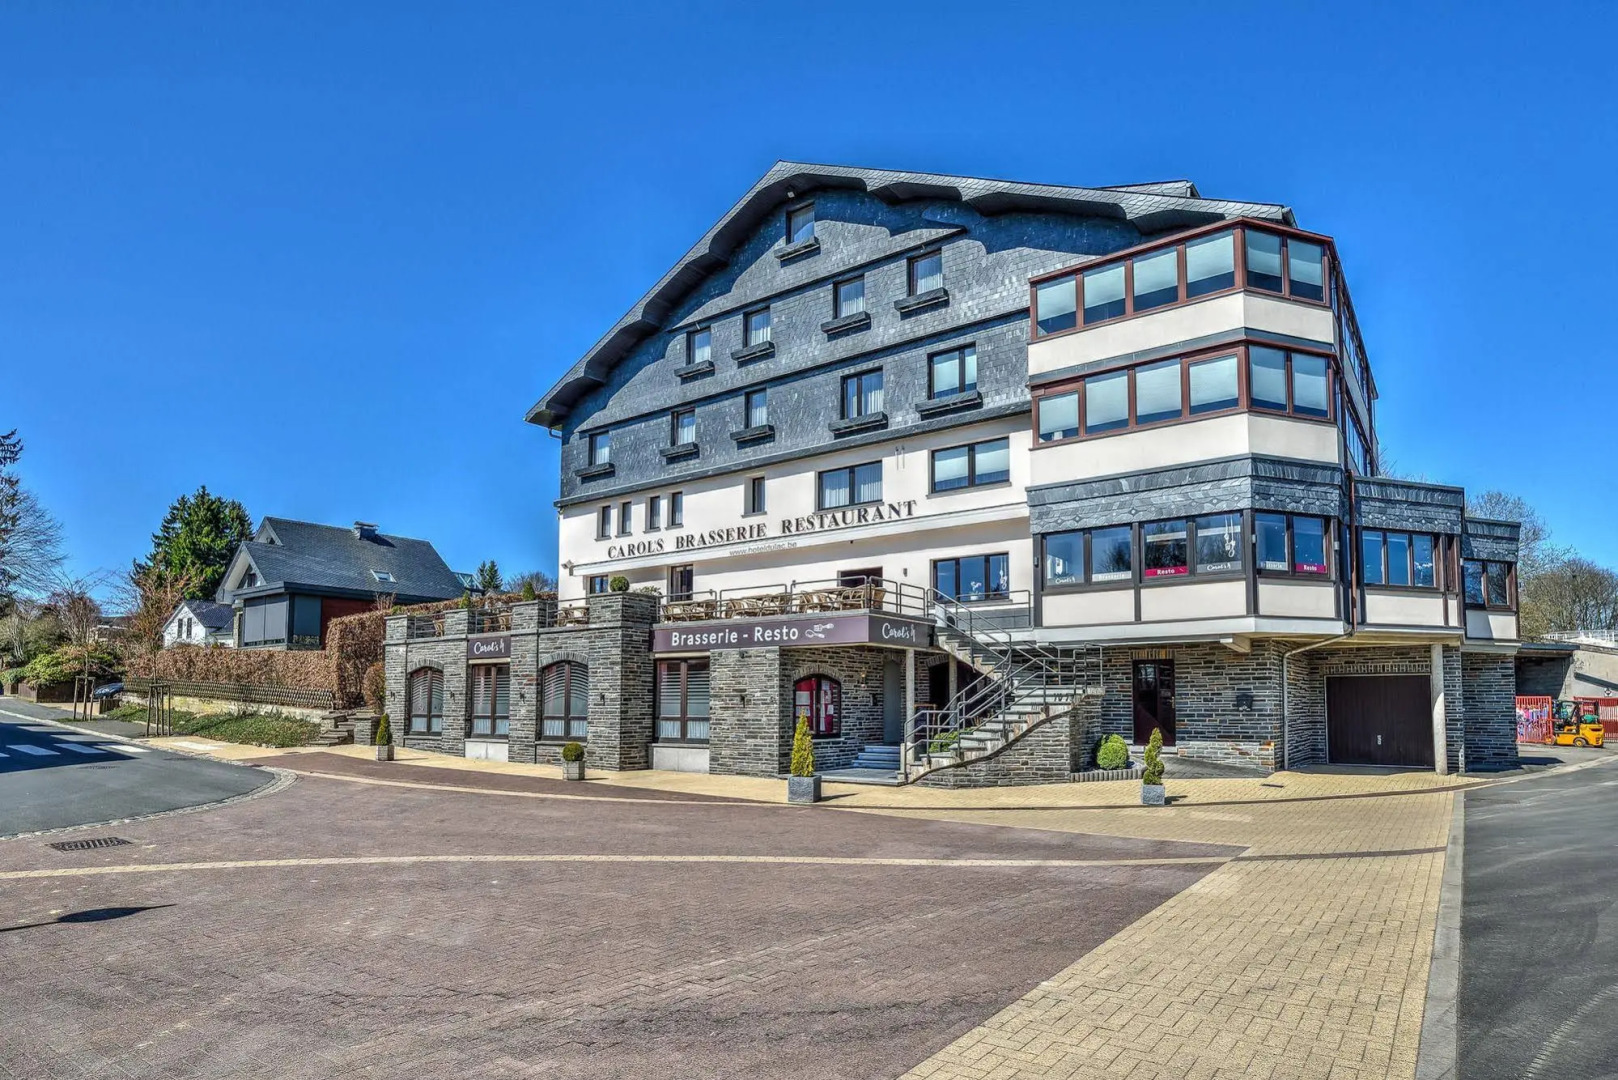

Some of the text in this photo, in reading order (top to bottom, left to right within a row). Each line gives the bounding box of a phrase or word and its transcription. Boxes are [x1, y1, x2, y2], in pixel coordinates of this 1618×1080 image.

[607, 500, 917, 559] CAROL'S BRASSERIE RESTAURANT
[671, 629, 738, 646] Brasserie
[754, 626, 799, 642] Resto
[882, 622, 910, 639] Carol's
[473, 641, 499, 655] Carol's
